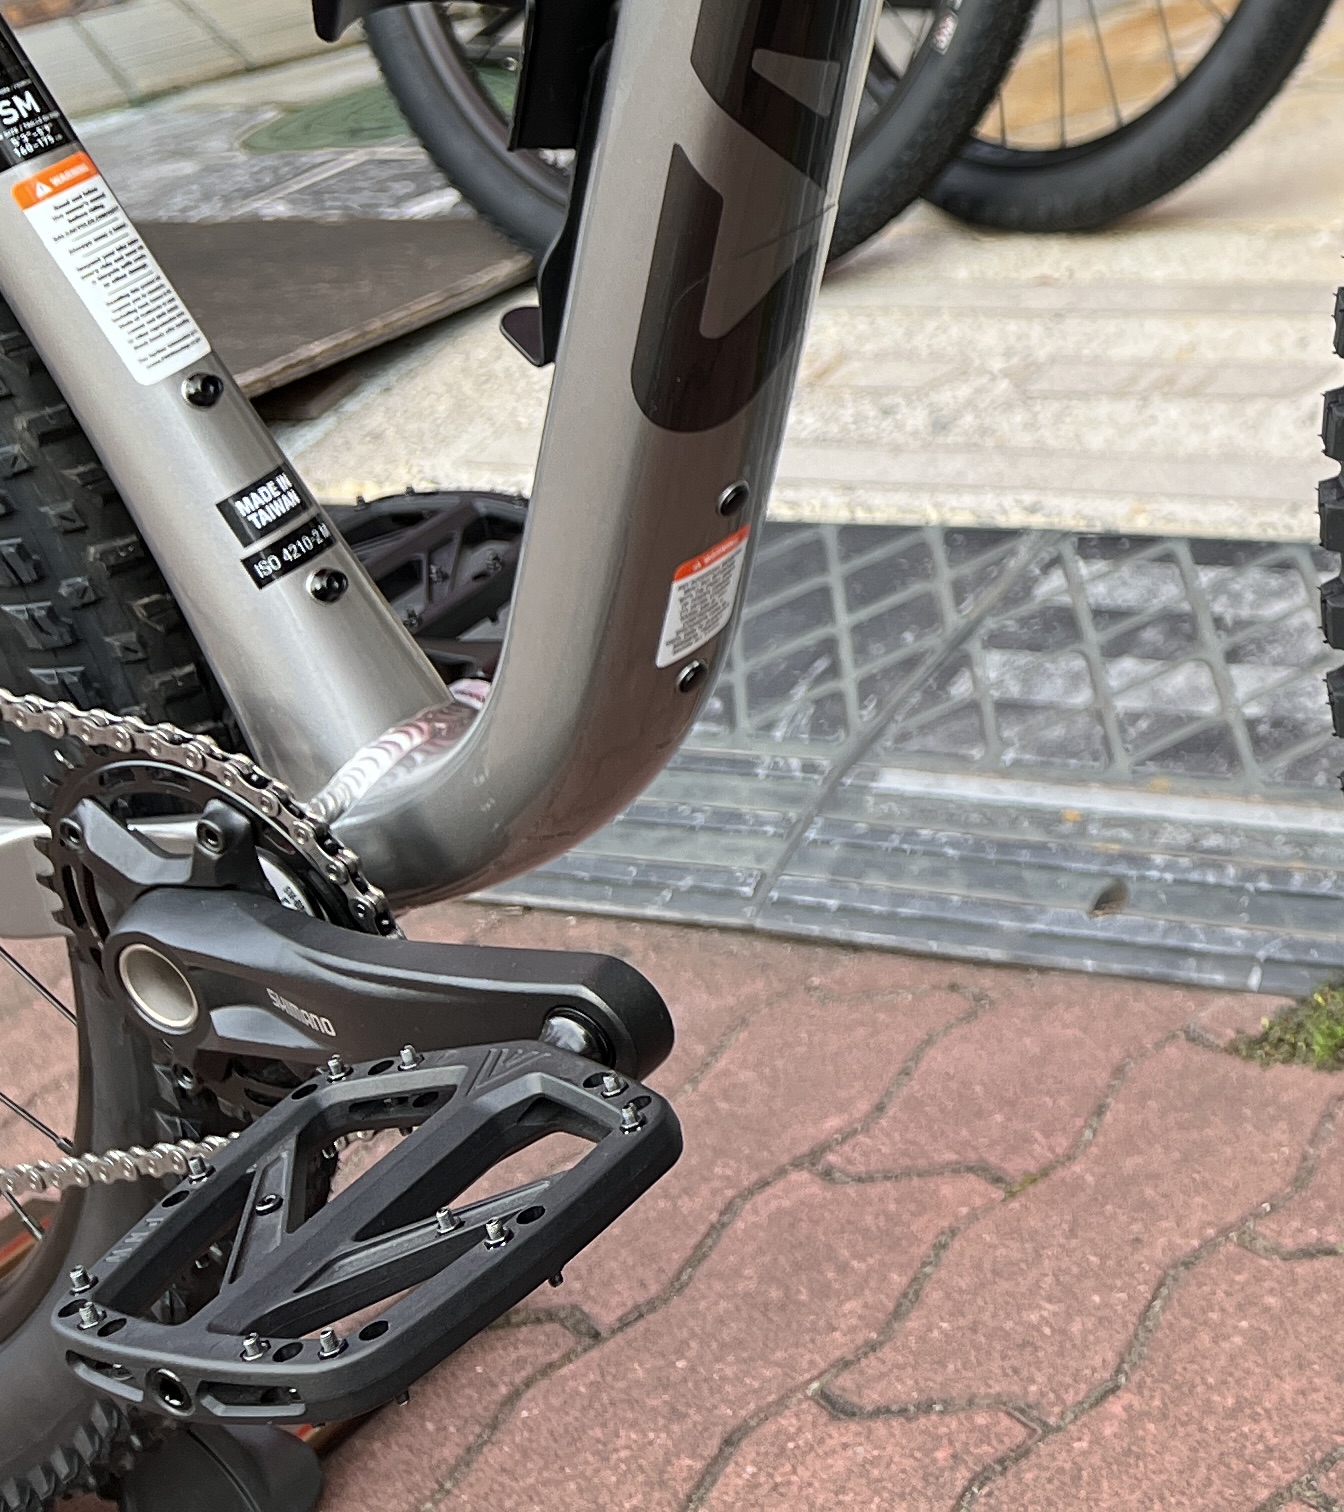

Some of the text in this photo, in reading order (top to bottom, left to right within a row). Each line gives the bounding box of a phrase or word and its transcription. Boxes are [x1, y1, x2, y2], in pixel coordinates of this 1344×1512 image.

[0, 90, 40, 125] SM
[235, 482, 282, 517] MADE
[247, 490, 301, 529] TAIWAN
[253, 554, 281, 579] ISO
[282, 529, 323, 563] 4210-2
[266, 985, 337, 1039] SHIMANO
